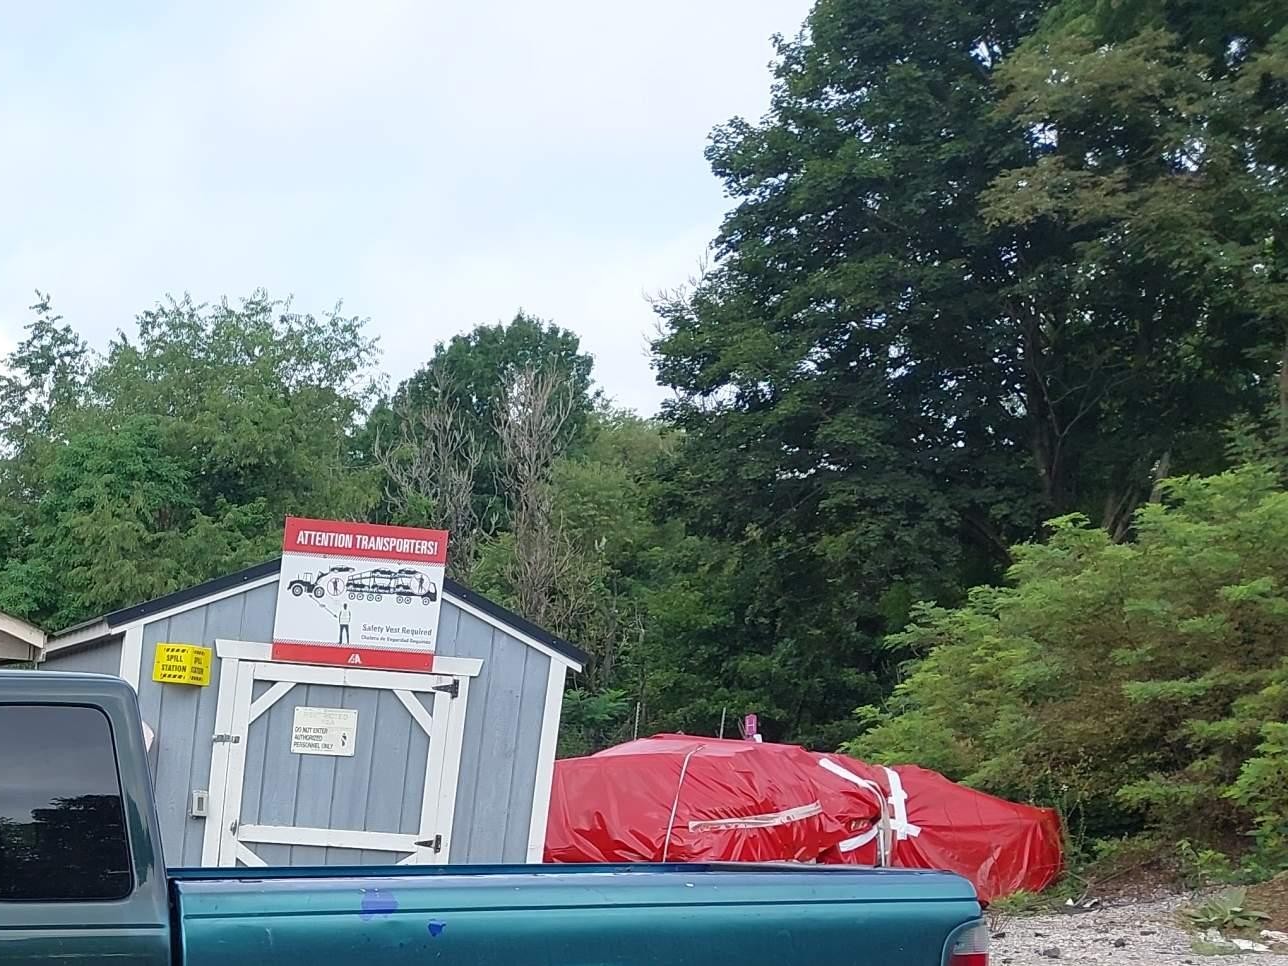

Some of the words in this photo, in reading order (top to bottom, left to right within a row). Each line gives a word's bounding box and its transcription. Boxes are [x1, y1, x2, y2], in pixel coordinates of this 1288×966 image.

[297, 530, 353, 549] ATTENTION
[356, 534, 438, 555] TRANSPORTERS!
[362, 623, 384, 634] Safety
[385, 625, 400, 633] Vest
[401, 626, 432, 636] Required
[166, 654, 183, 662] SPILL
[161, 664, 187, 672] STATION
